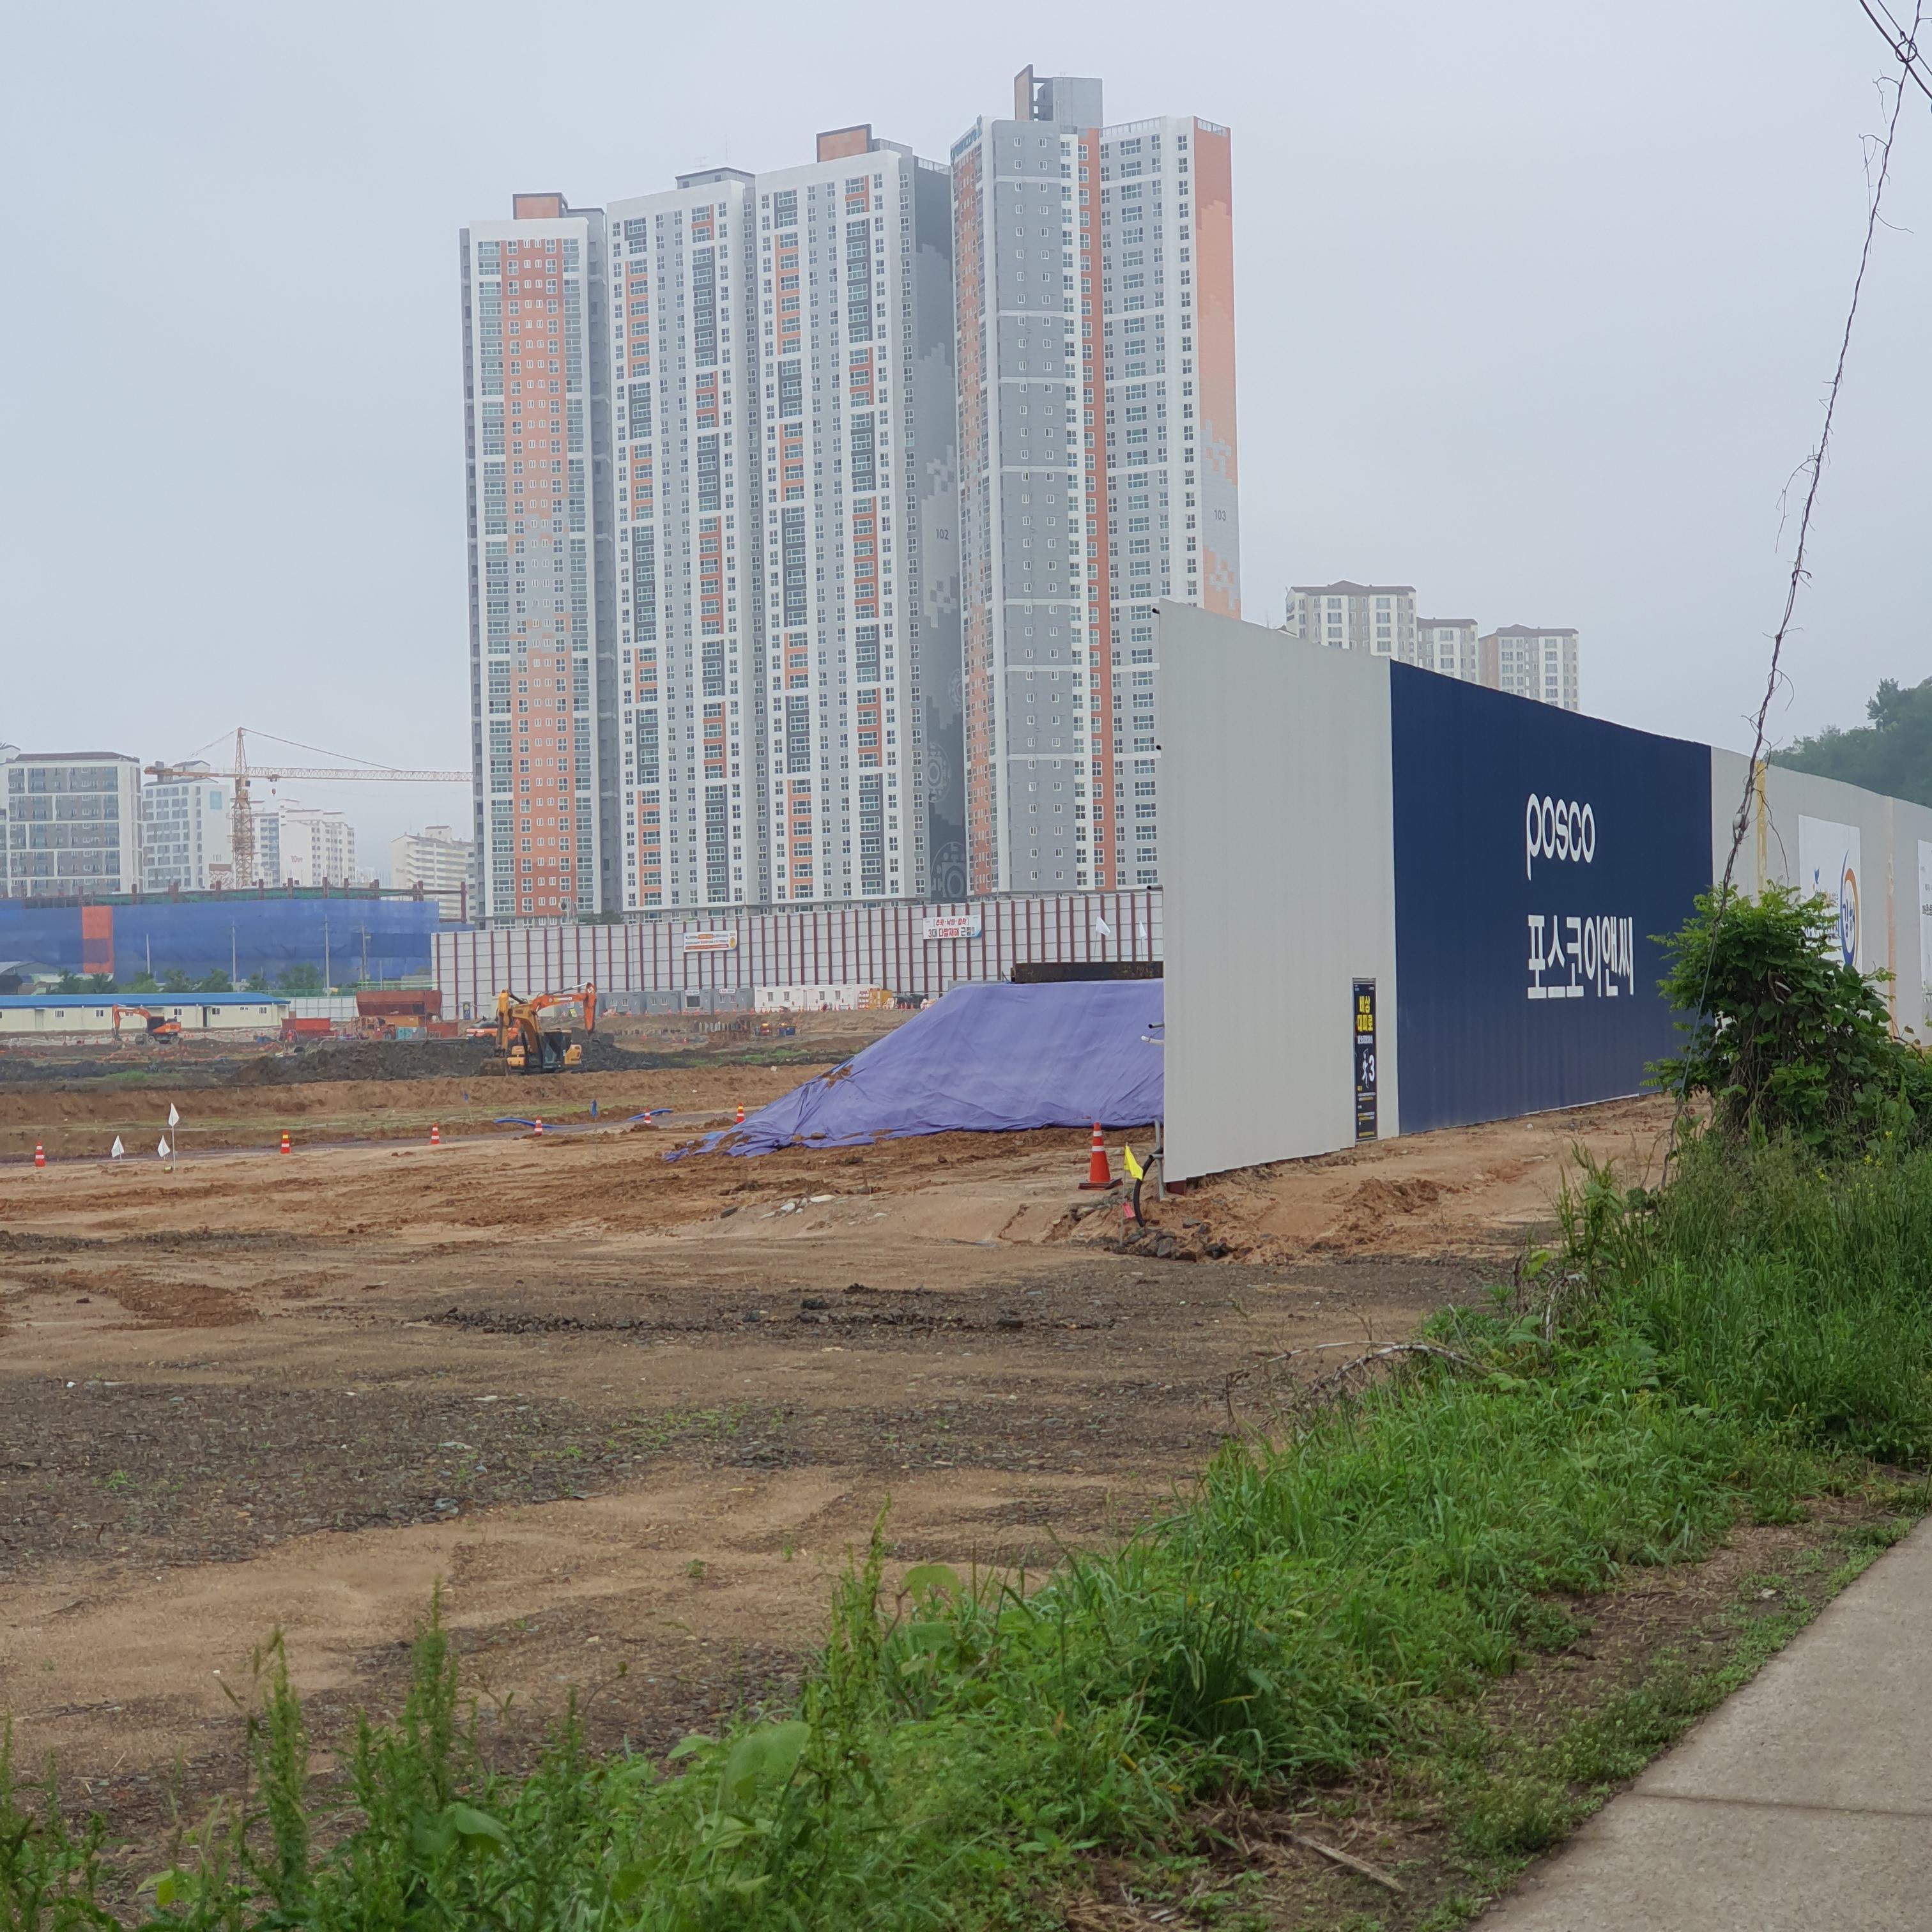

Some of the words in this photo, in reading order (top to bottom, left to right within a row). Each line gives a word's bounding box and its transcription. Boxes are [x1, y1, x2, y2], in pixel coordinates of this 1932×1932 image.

[1213, 509, 1227, 521] 103
[935, 528, 949, 540] 102
[1526, 793, 1596, 881] posco
[1528, 914, 1634, 999] 포스코이앤씨
[1359, 995, 1371, 1013] 비상
[1357, 1014, 1373, 1032] 대피로
